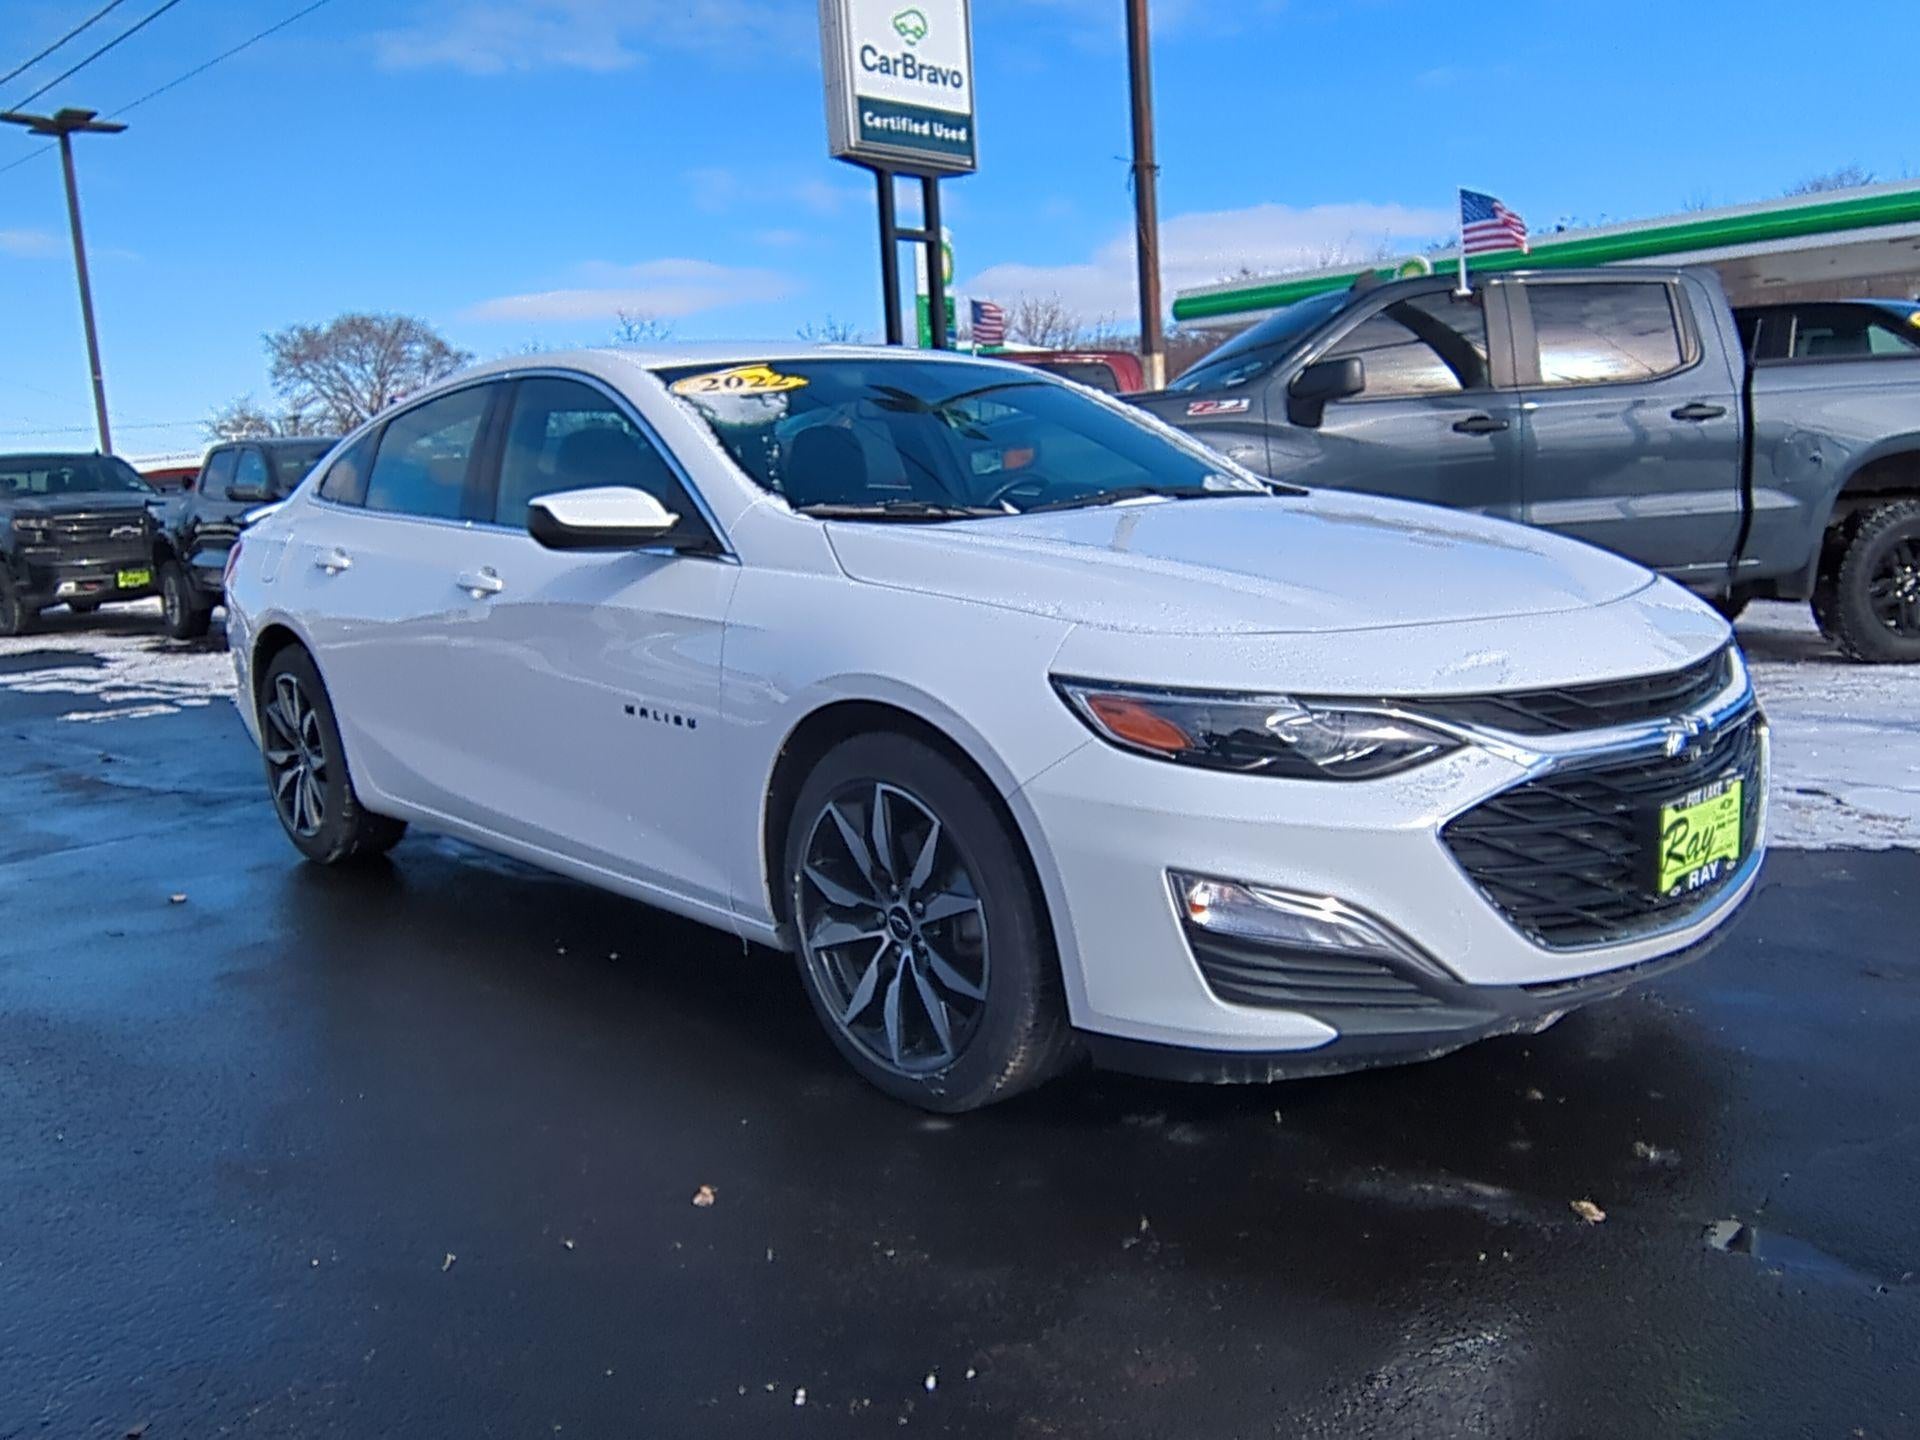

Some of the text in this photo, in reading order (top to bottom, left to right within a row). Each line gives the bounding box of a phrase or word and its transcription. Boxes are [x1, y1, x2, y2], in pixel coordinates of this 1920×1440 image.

[860, 44, 963, 89] CarBravo
[863, 111, 967, 142] Certified Used
[700, 374, 791, 392] 2022
[624, 703, 696, 729] MALIBU
[1660, 816, 1715, 874] Ray
[1688, 859, 1720, 890] RAY
